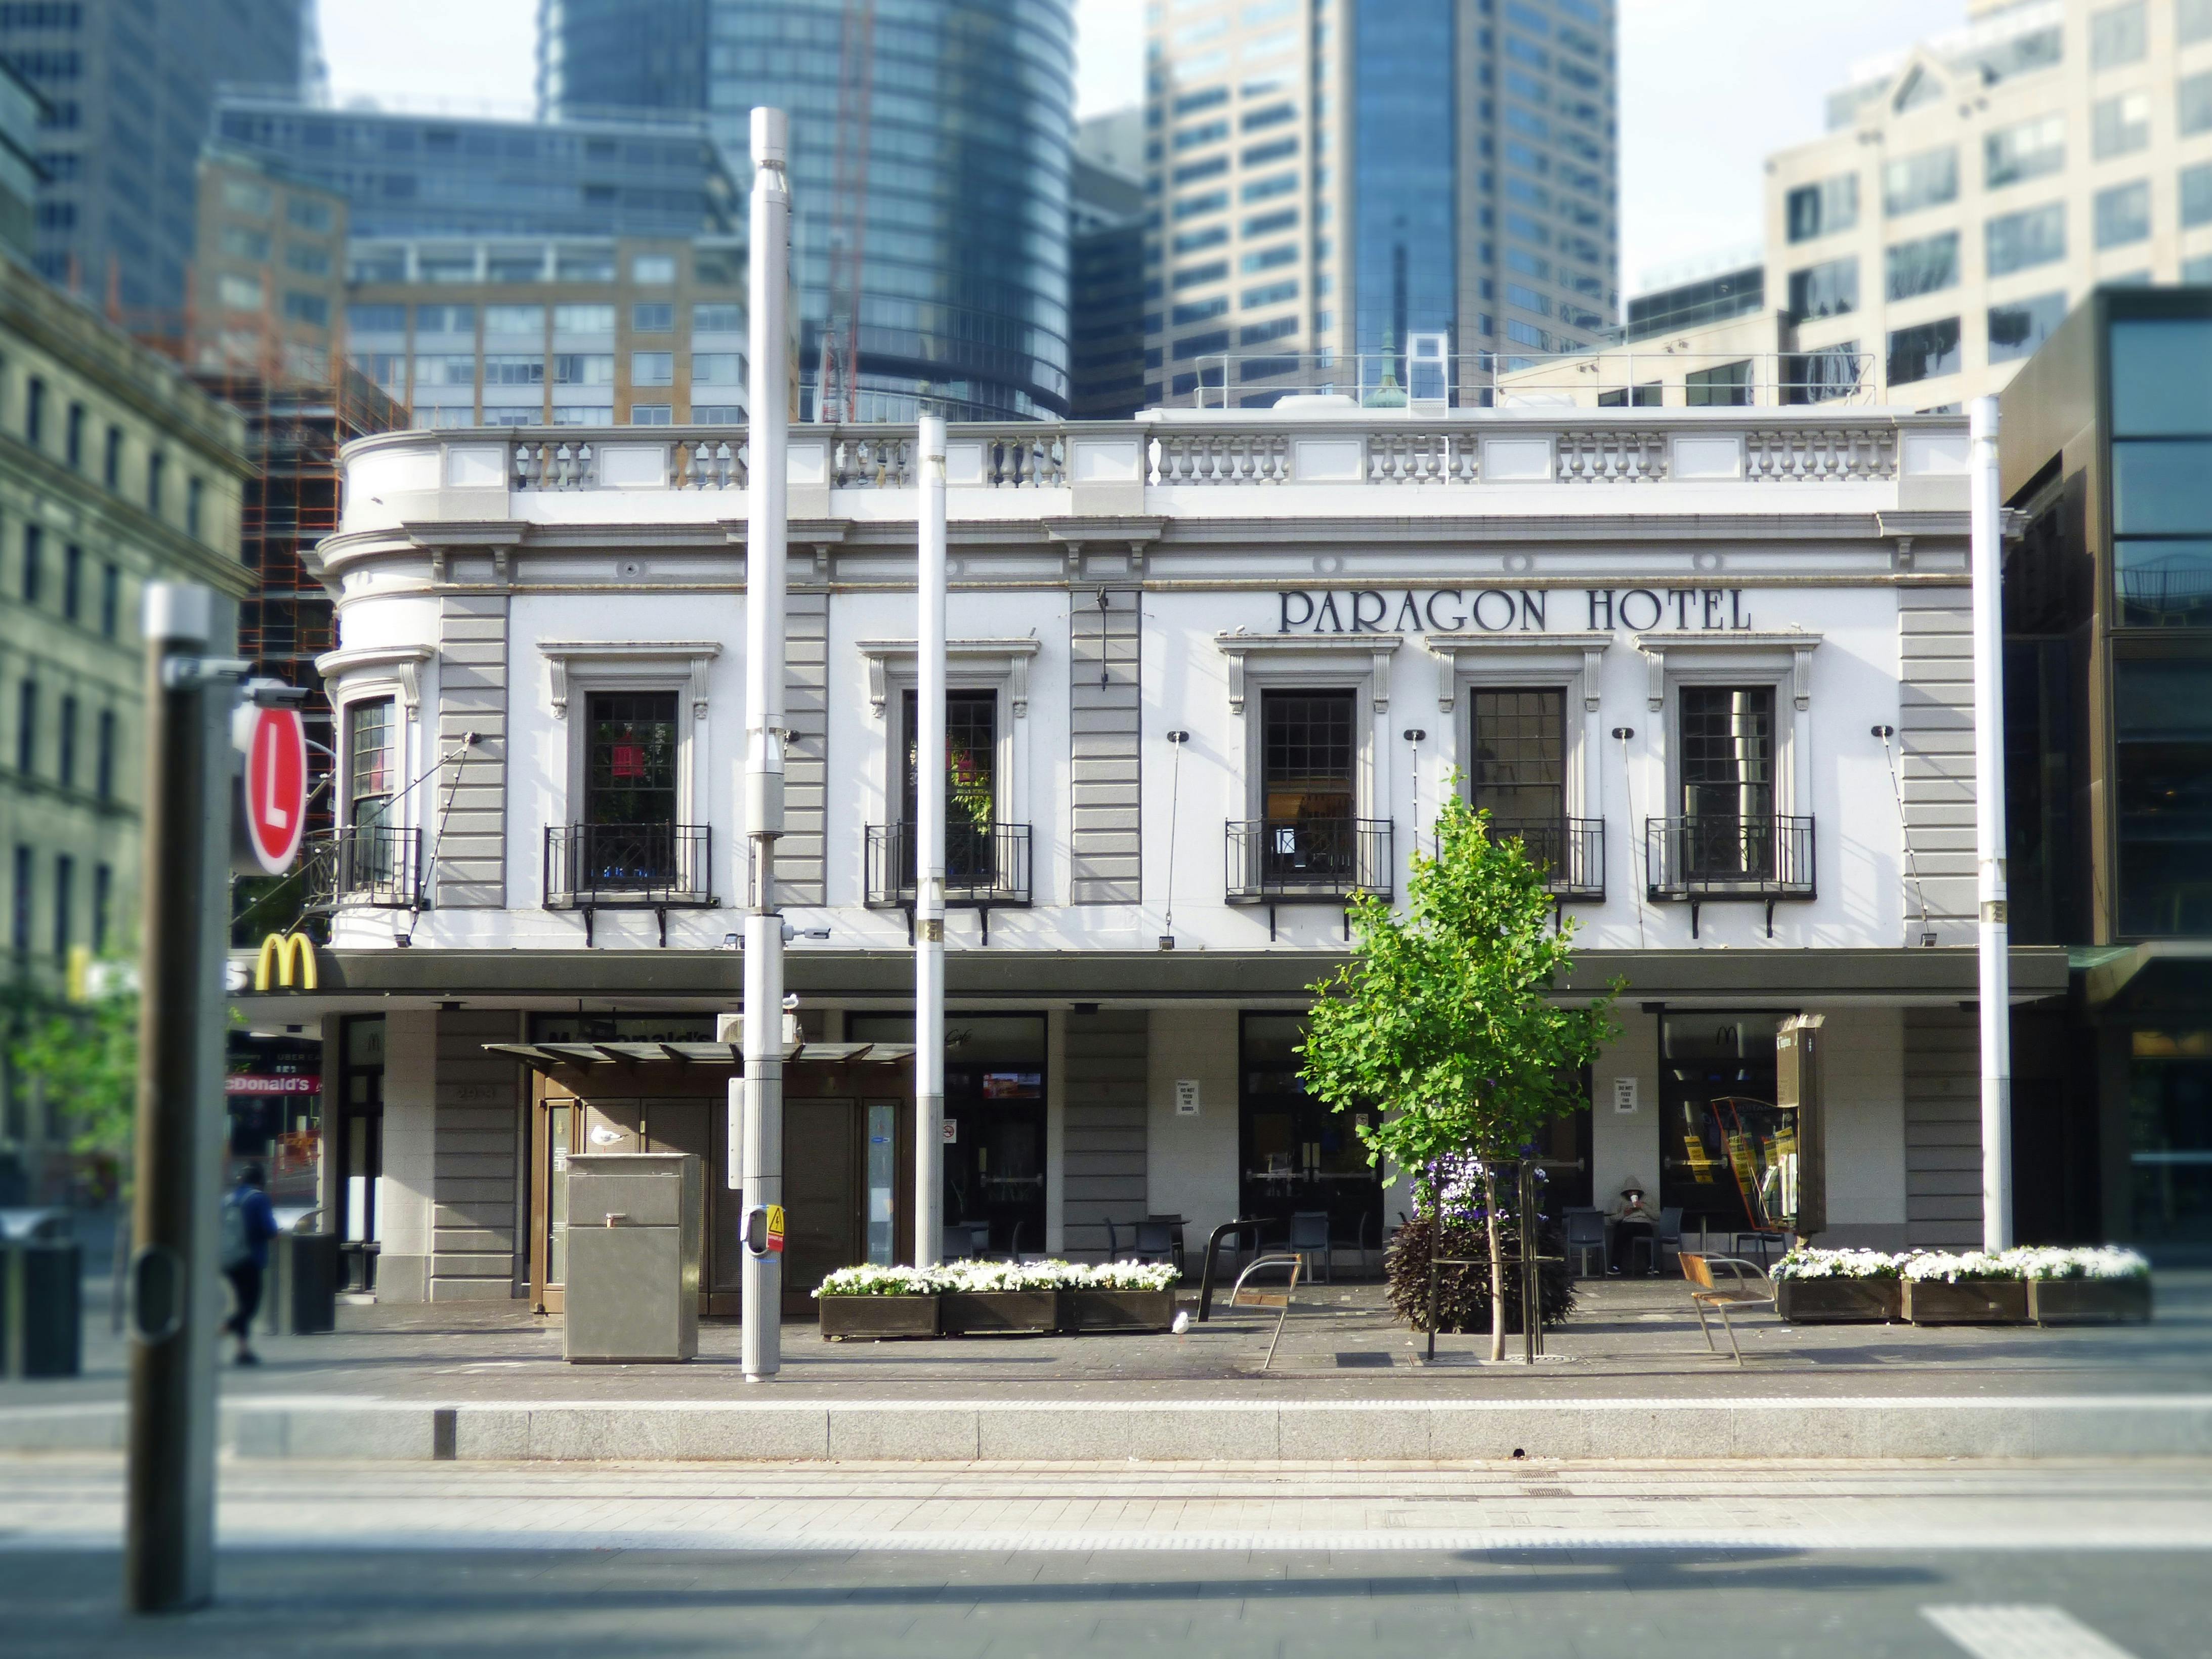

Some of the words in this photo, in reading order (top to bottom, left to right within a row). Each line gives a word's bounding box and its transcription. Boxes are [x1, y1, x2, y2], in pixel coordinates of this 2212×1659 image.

[1279, 589, 1548, 632] PARAGON
[1586, 588, 1751, 631] HOTEL
[265, 721, 287, 829] L
[225, 1078, 310, 1091] cDonald's
